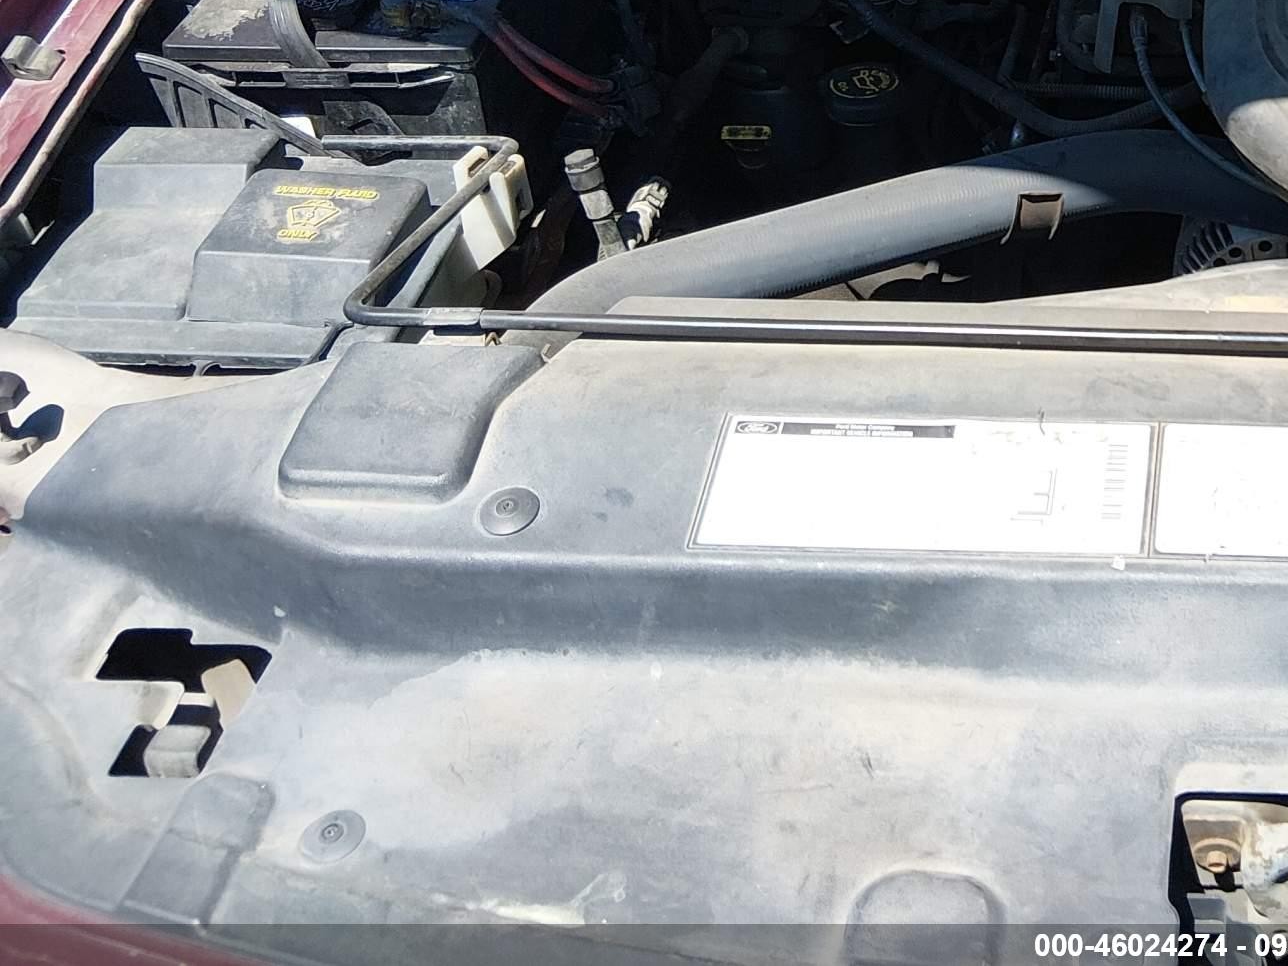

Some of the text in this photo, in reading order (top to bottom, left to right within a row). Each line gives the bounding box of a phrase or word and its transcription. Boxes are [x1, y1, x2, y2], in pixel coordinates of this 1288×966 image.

[275, 185, 379, 201] WASHER FLUID
[278, 228, 318, 241] ONLY
